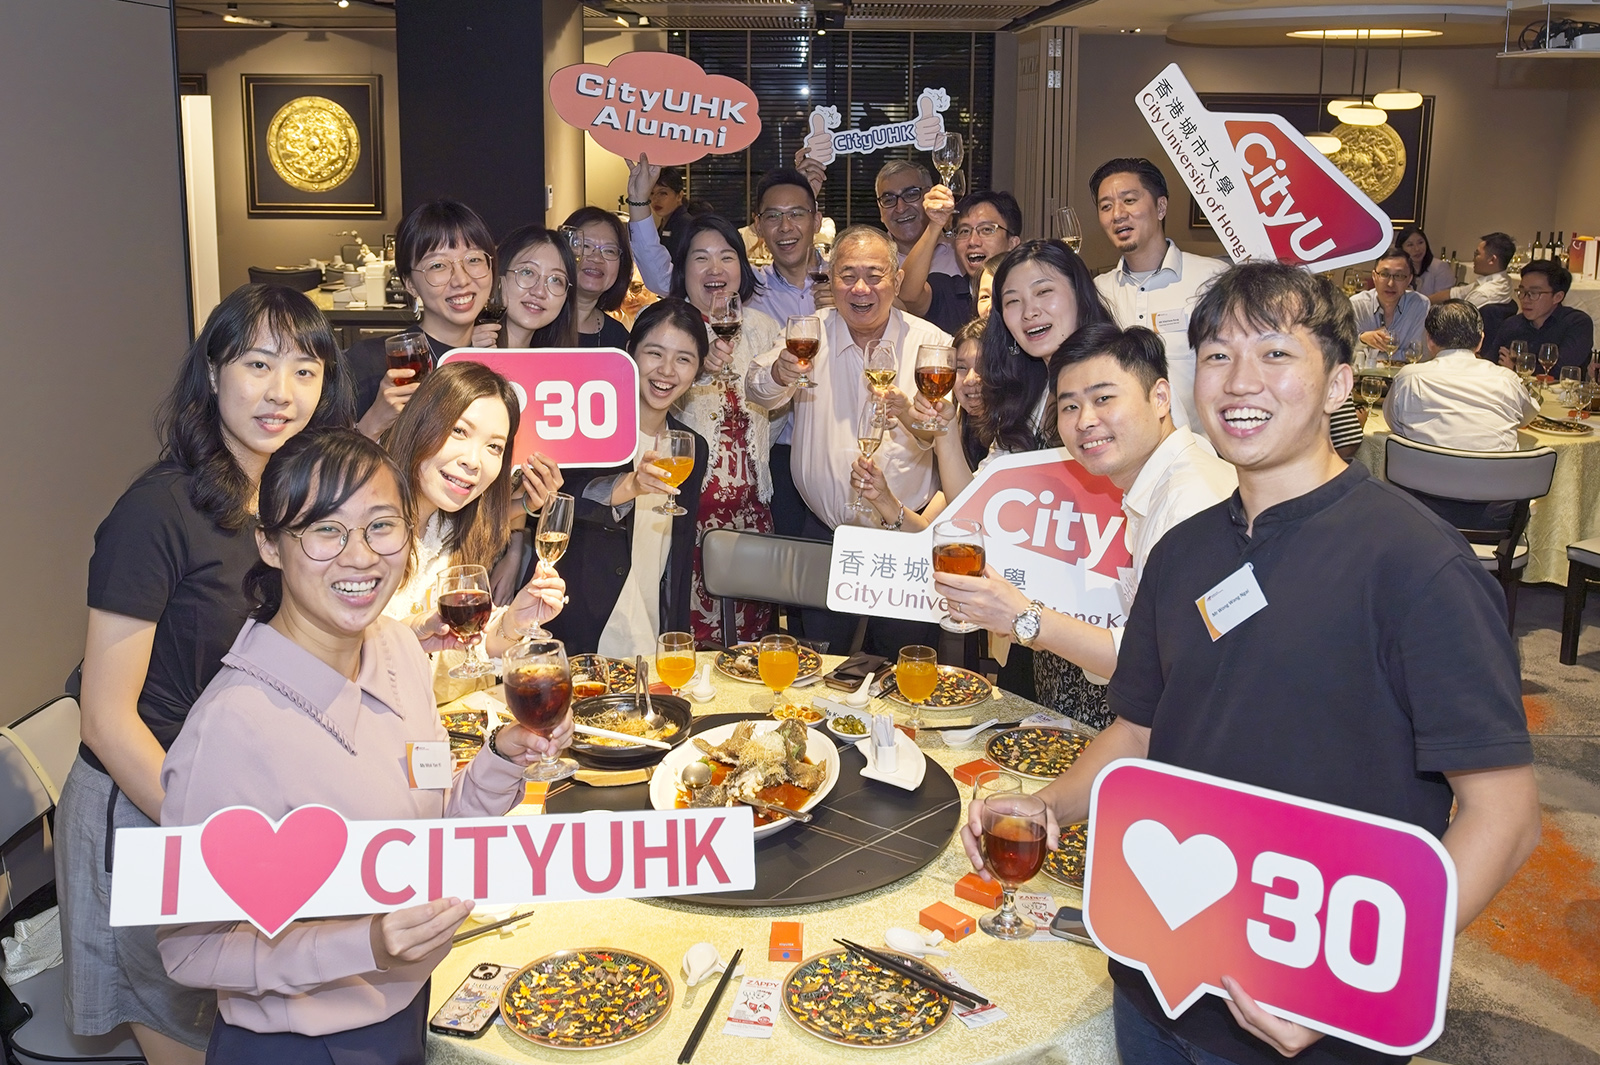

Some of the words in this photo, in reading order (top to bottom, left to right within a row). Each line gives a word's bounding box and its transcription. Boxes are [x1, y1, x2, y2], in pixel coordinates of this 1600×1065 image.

[576, 72, 748, 124] CityUHK
[591, 105, 727, 148] Alumni
[834, 124, 916, 151] CityUHK
[1155, 78, 1235, 197] 香港城市大學
[1143, 92, 1165, 123] City
[1161, 121, 1210, 195] University
[1206, 197, 1225, 214] of
[1217, 213, 1247, 258] Hong
[1235, 132, 1337, 261] CityU
[535, 380, 617, 440] 30
[983, 488, 1133, 570] City
[835, 581, 884, 608] City
[888, 588, 948, 611] Unive
[161, 836, 182, 915] I
[360, 817, 731, 905] CITYUHK
[1246, 851, 1406, 993] 30
[746, 980, 780, 988] ZAPPY
